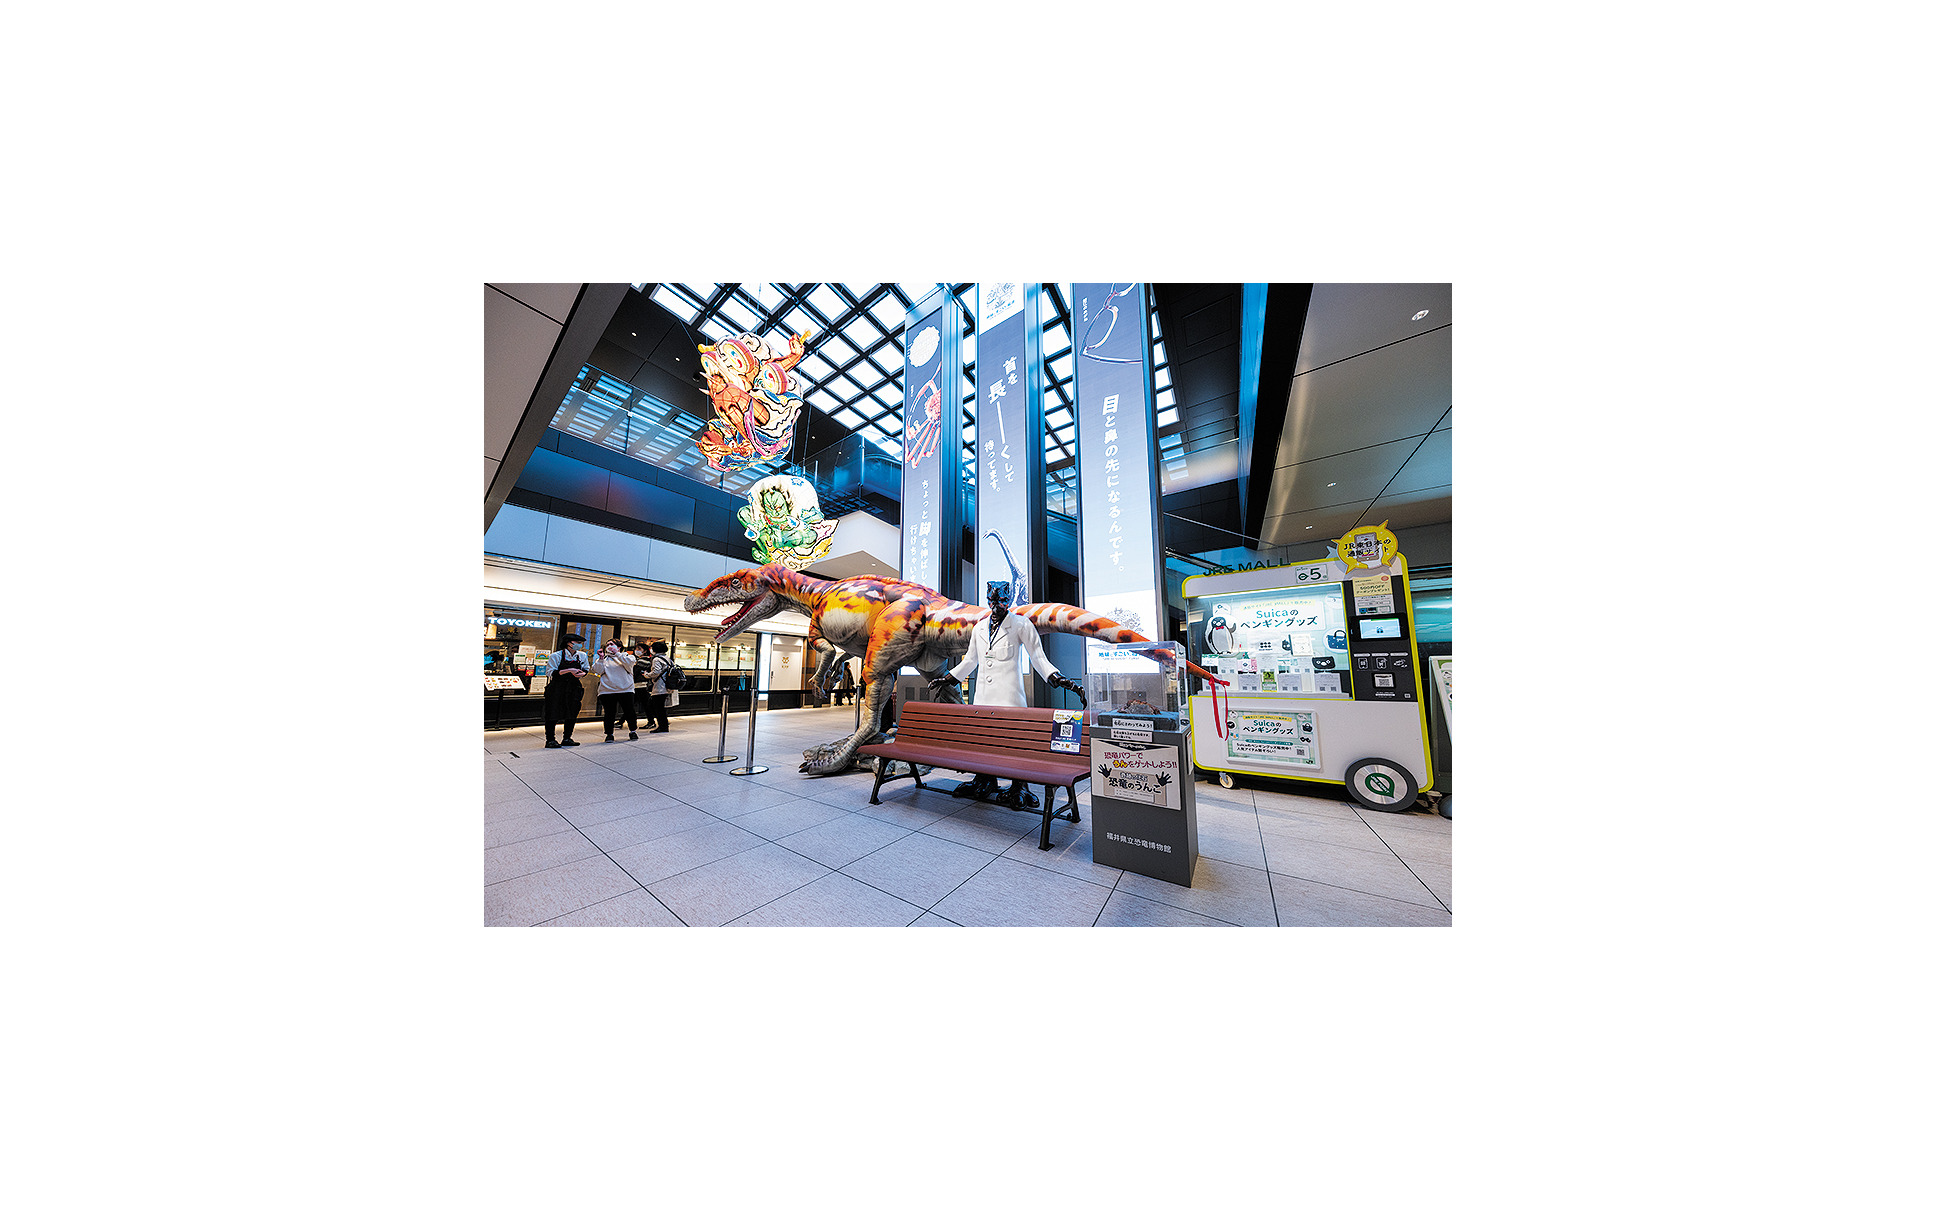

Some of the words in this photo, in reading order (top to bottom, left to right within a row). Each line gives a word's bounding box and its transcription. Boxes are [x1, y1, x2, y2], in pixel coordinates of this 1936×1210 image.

[1102, 394, 1126, 572] 目と鼻の先になるんです。
[1203, 564, 1235, 576] JRE
[1238, 558, 1291, 572] MALL
[1256, 609, 1299, 619] Suicaの
[488, 617, 551, 629] TOYOKEN
[1240, 616, 1318, 629] ペンギングッズ
[1253, 720, 1282, 728] Suicaの
[1243, 726, 1294, 735] ペンギングッズ
[1104, 752, 1143, 760] 恐竜パワーで
[1109, 777, 1161, 794] 恐竜のうんこ
[1106, 832, 1172, 854] 福井県立恐竜博物館
